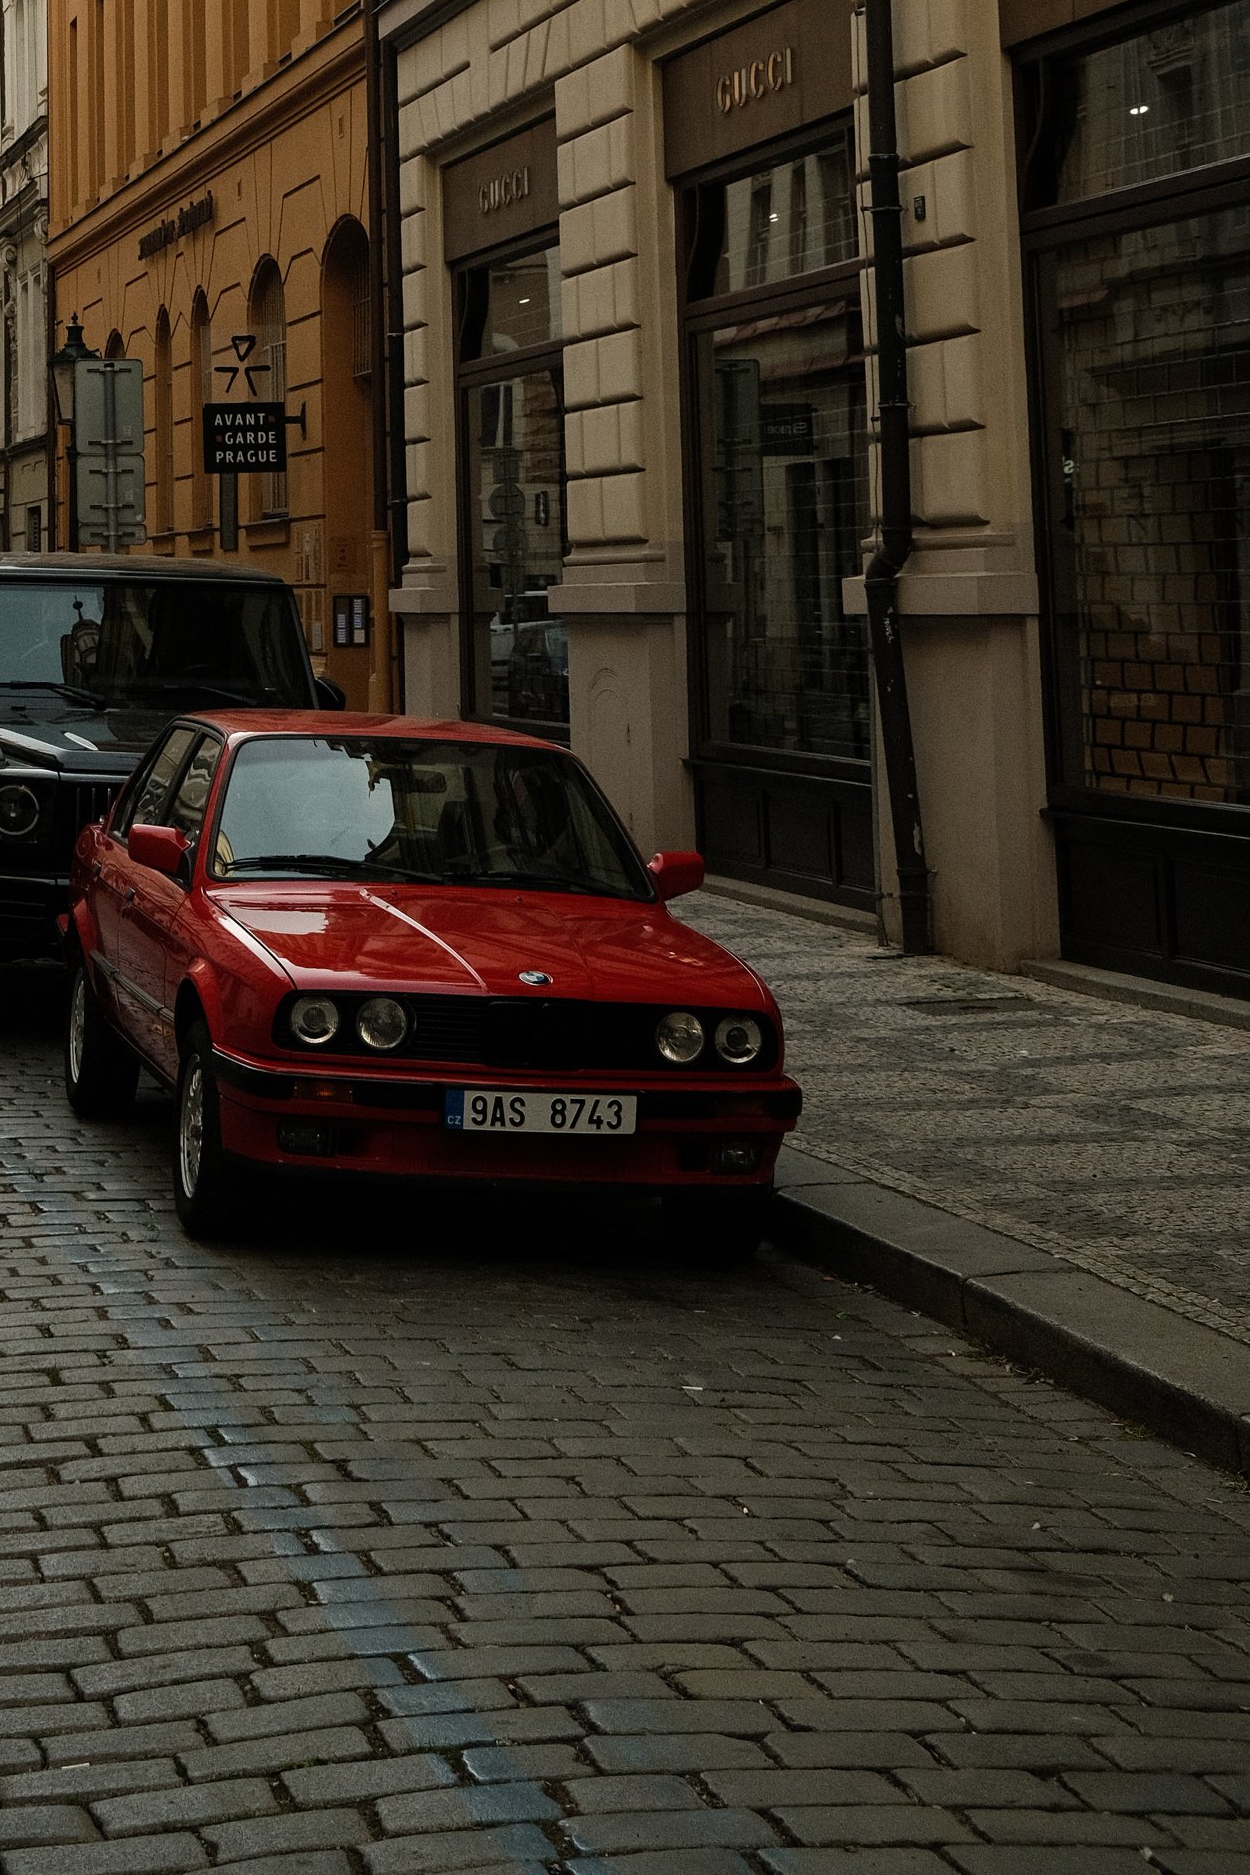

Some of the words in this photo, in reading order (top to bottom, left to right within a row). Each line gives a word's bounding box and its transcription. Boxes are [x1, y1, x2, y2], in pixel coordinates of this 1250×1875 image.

[714, 46, 796, 116] GUCCI
[477, 164, 530, 217] GUCCI
[214, 413, 266, 426] AVANT
[224, 431, 277, 444] GARDE
[215, 450, 278, 463] PRAGUE
[470, 1095, 526, 1128] 9AS
[550, 1098, 623, 1130] 8743
[447, 1116, 461, 1125] CZ
